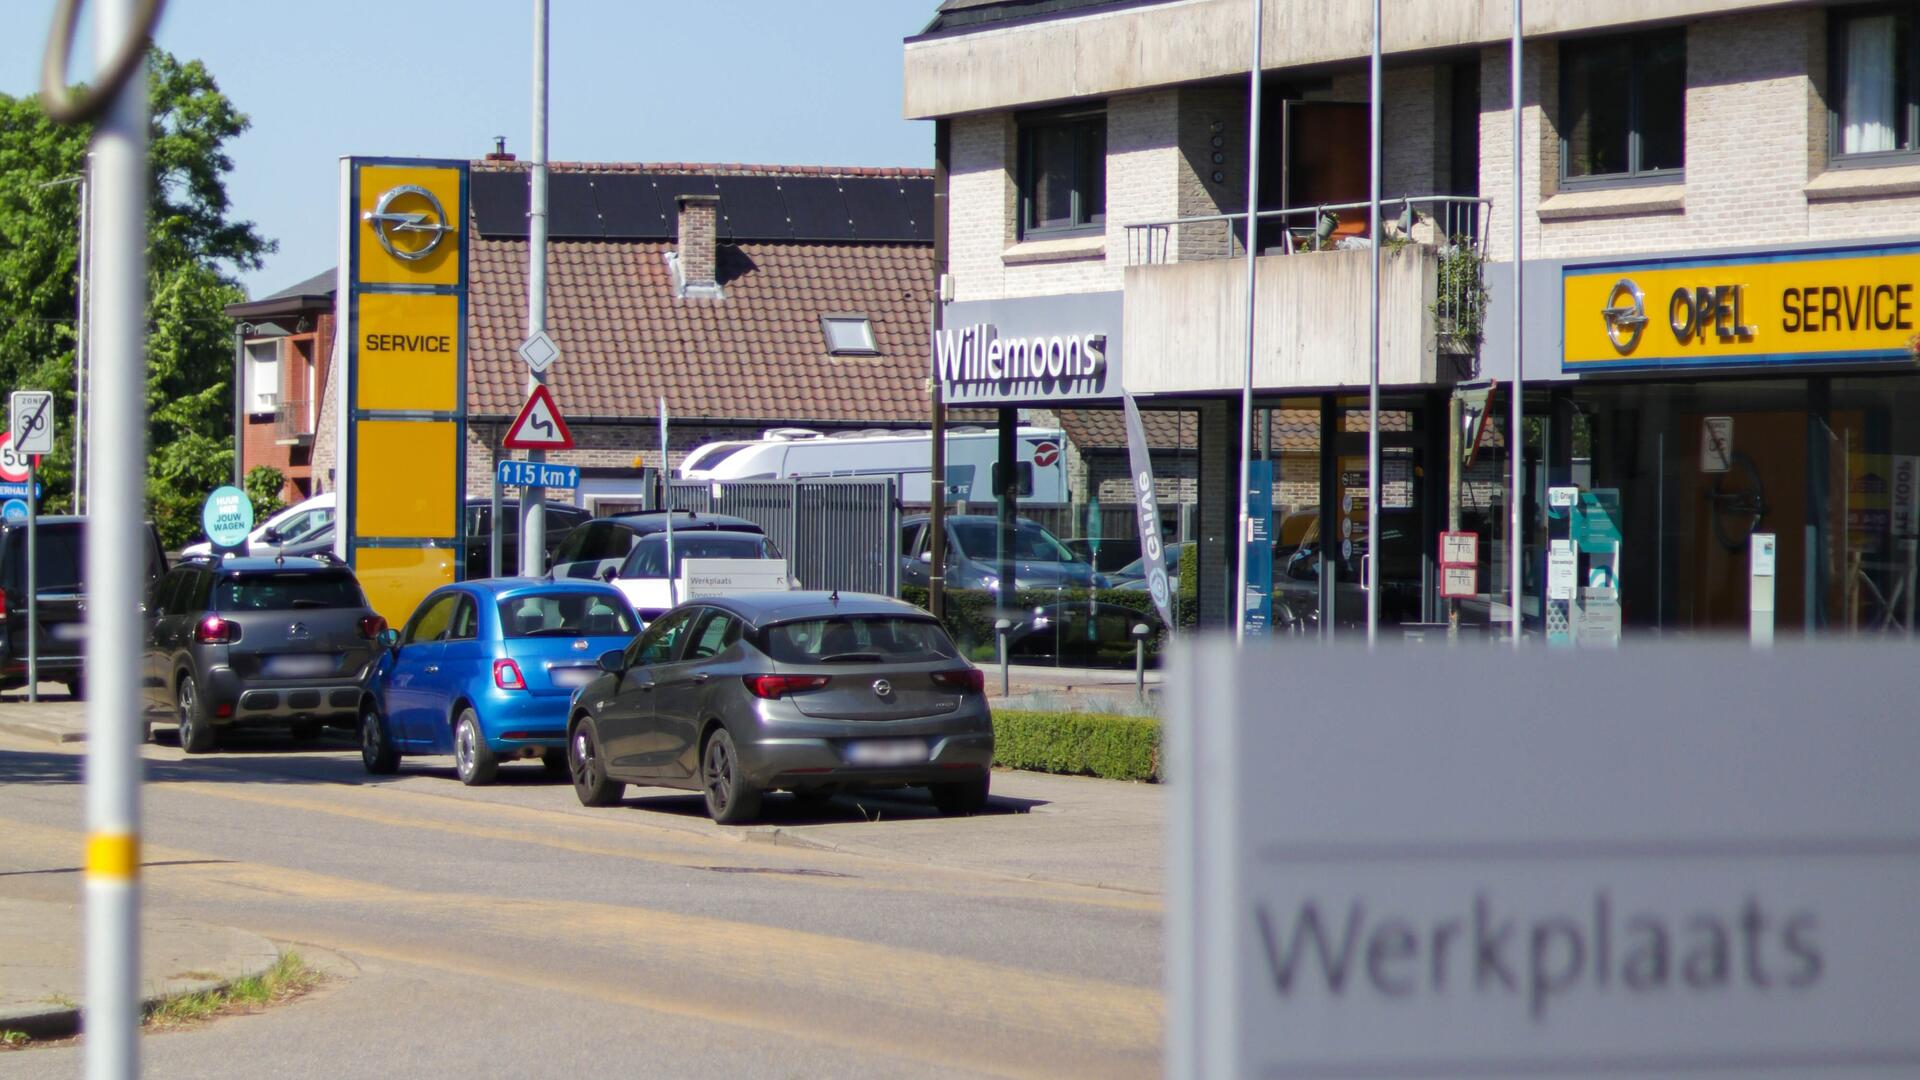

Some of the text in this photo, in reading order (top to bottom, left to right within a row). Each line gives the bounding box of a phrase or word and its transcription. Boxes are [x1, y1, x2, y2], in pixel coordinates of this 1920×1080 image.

[1669, 284, 1914, 344] OPEL SERVICE
[366, 334, 450, 353] SERVICE
[936, 323, 1106, 382] Willemoons
[22, 415, 44, 431] 30
[3, 449, 29, 466] 50
[515, 464, 565, 486] 1.5 km
[213, 521, 245, 532] WAGEN
[216, 513, 242, 523] JOUW
[690, 576, 731, 586] Werkplaats
[1256, 888, 1824, 1022] Werkplaats
